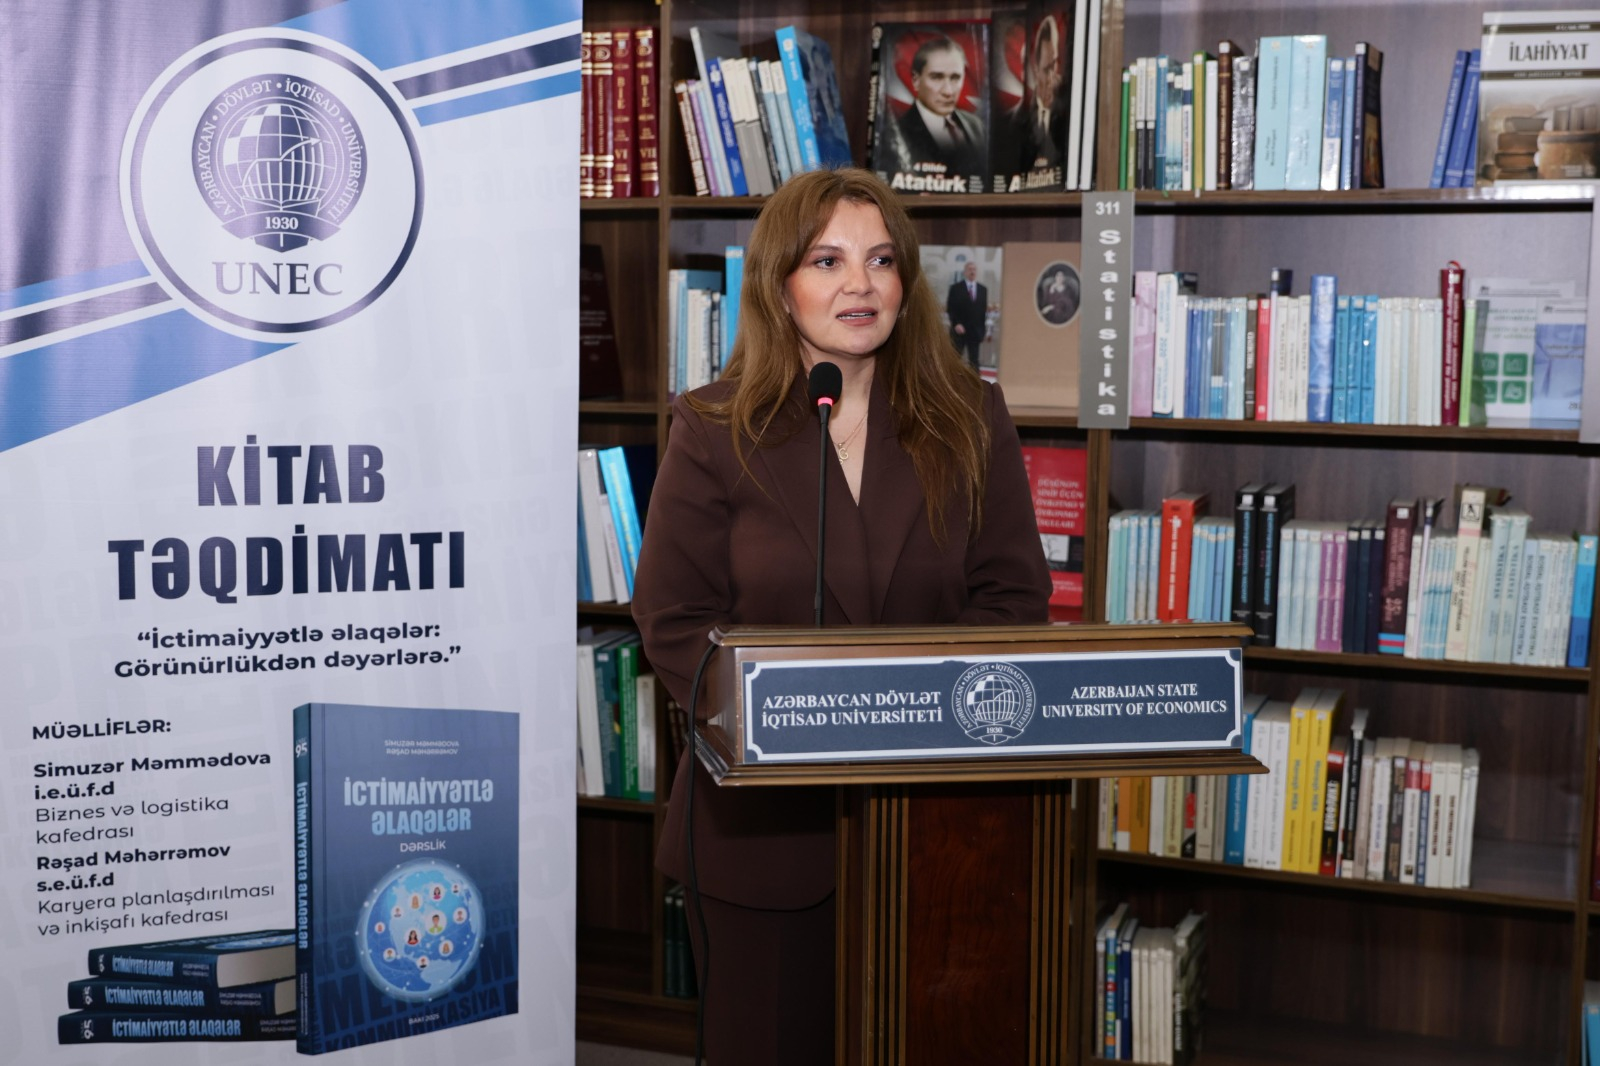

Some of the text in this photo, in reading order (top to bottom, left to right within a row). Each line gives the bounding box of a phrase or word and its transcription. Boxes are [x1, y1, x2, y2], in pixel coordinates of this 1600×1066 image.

[1509, 40, 1589, 62] İLAHİYYAT
[198, 78, 364, 222] AZƏRBAYCAN DÖVLƏT İQTİSAD UNİVERSİTETİ
[891, 172, 966, 193] Atatürk
[1095, 201, 1120, 215] 311
[265, 217, 299, 230] 1930
[212, 262, 343, 296] UNEC
[197, 435, 385, 507] KİTAB
[108, 524, 465, 603] TƏQDİMATI
[137, 622, 441, 650] “İctimaiyyətlə əlaqələr:
[114, 645, 462, 678] Görünürlükdən dəyərlərə.”
[763, 690, 941, 709] AZƏRBAYCAN DÖVLƏT
[1070, 683, 1198, 700] AZERBAIJAN STATE
[762, 707, 943, 729] İQTİSAD UNİVERSİTETİ
[1042, 700, 1227, 718] UNIVERSITY OF ECONOMICS
[32, 718, 171, 740] MÜƏLLİFLƏR:
[34, 752, 271, 778] Simuzər Məmmədova
[34, 781, 115, 800] i.e.ü.f.d
[344, 776, 494, 806] İCTİMAİYYƏTLƏ
[36, 797, 229, 822] Biznes və logistika
[372, 808, 472, 835] ƏLAQƏLƏR
[36, 826, 134, 844] kafedrası
[400, 839, 446, 852] DƏRSLİK
[37, 845, 231, 872] Rəşad Məhərrəmov
[37, 872, 114, 892] s.e.ü.f.d
[38, 885, 274, 915] Karyera planlaşdırılması
[38, 909, 228, 936] və inkişafı kafedrası
[112, 1019, 241, 1037] İCTİMAİYYƏTLƏ ƏLAQƏLƏR
